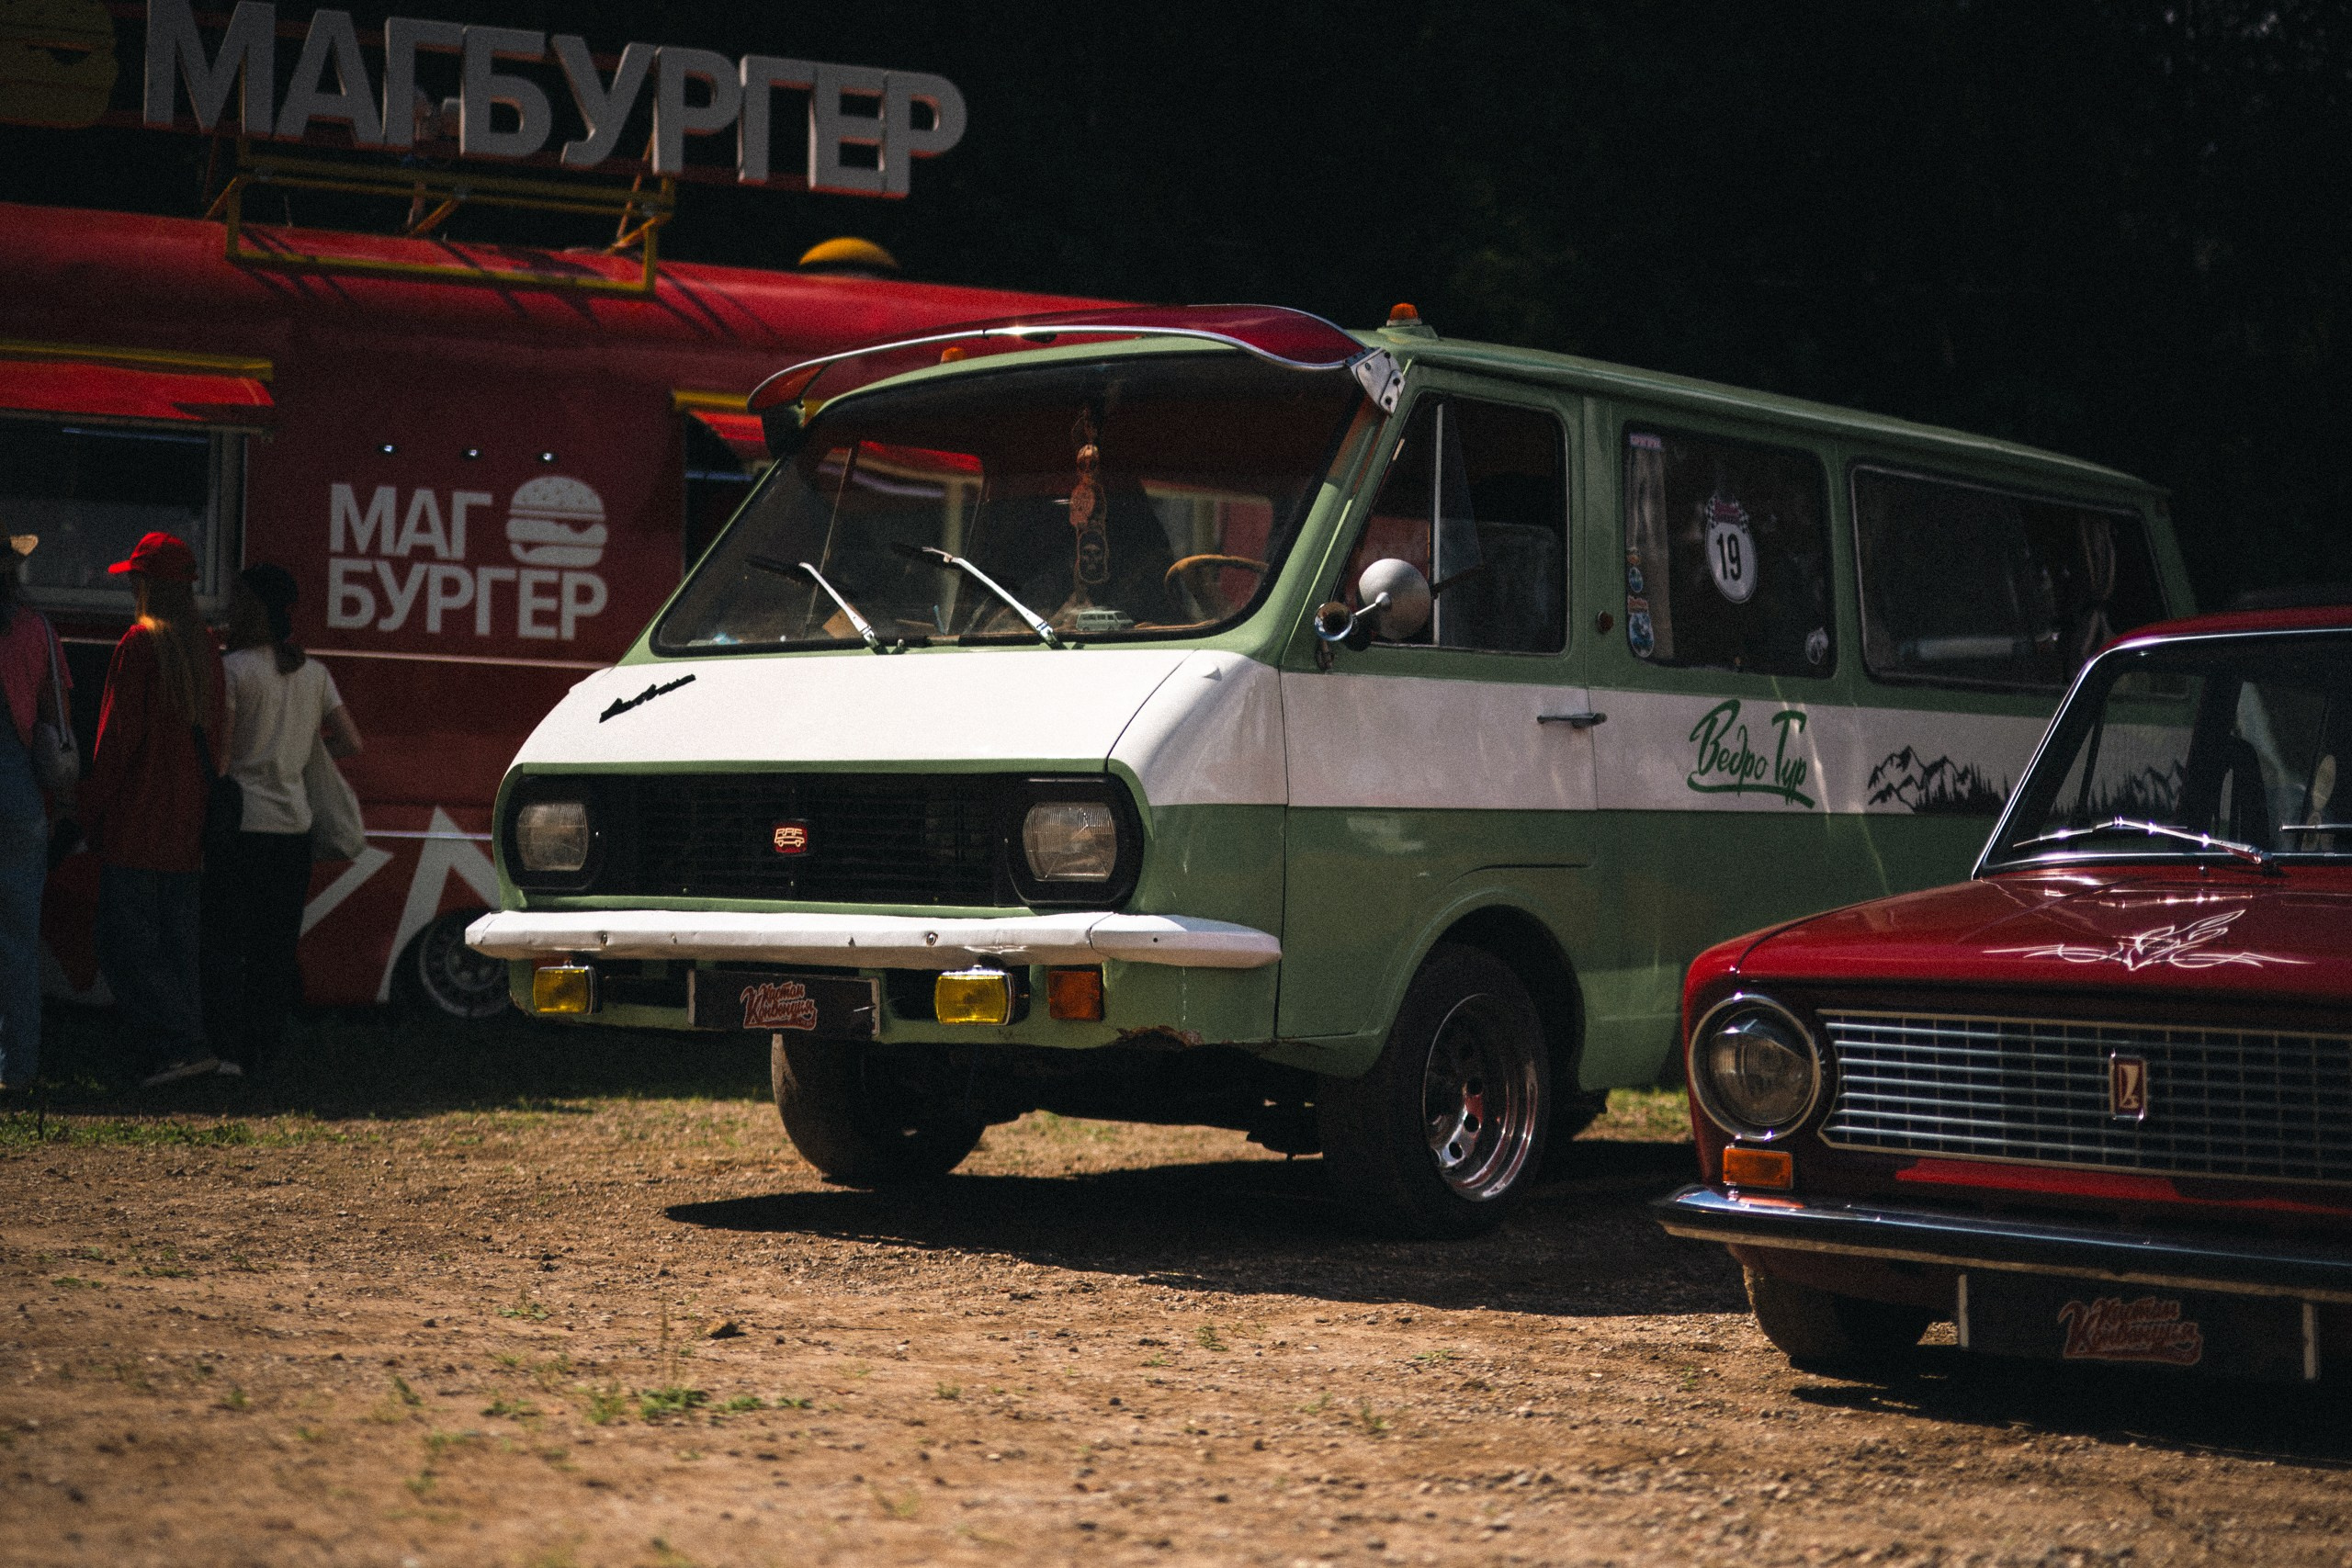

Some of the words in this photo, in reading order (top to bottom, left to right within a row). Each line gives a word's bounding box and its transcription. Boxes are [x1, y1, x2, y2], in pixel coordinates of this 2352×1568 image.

[143, 0, 967, 197] МАГБУРГЕР
[329, 482, 493, 562] МАГ
[1716, 533, 1742, 581] 19
[327, 557, 609, 641] БУРГЕР
[1689, 698, 1770, 797] Ведро
[1771, 709, 1808, 806] Тур
